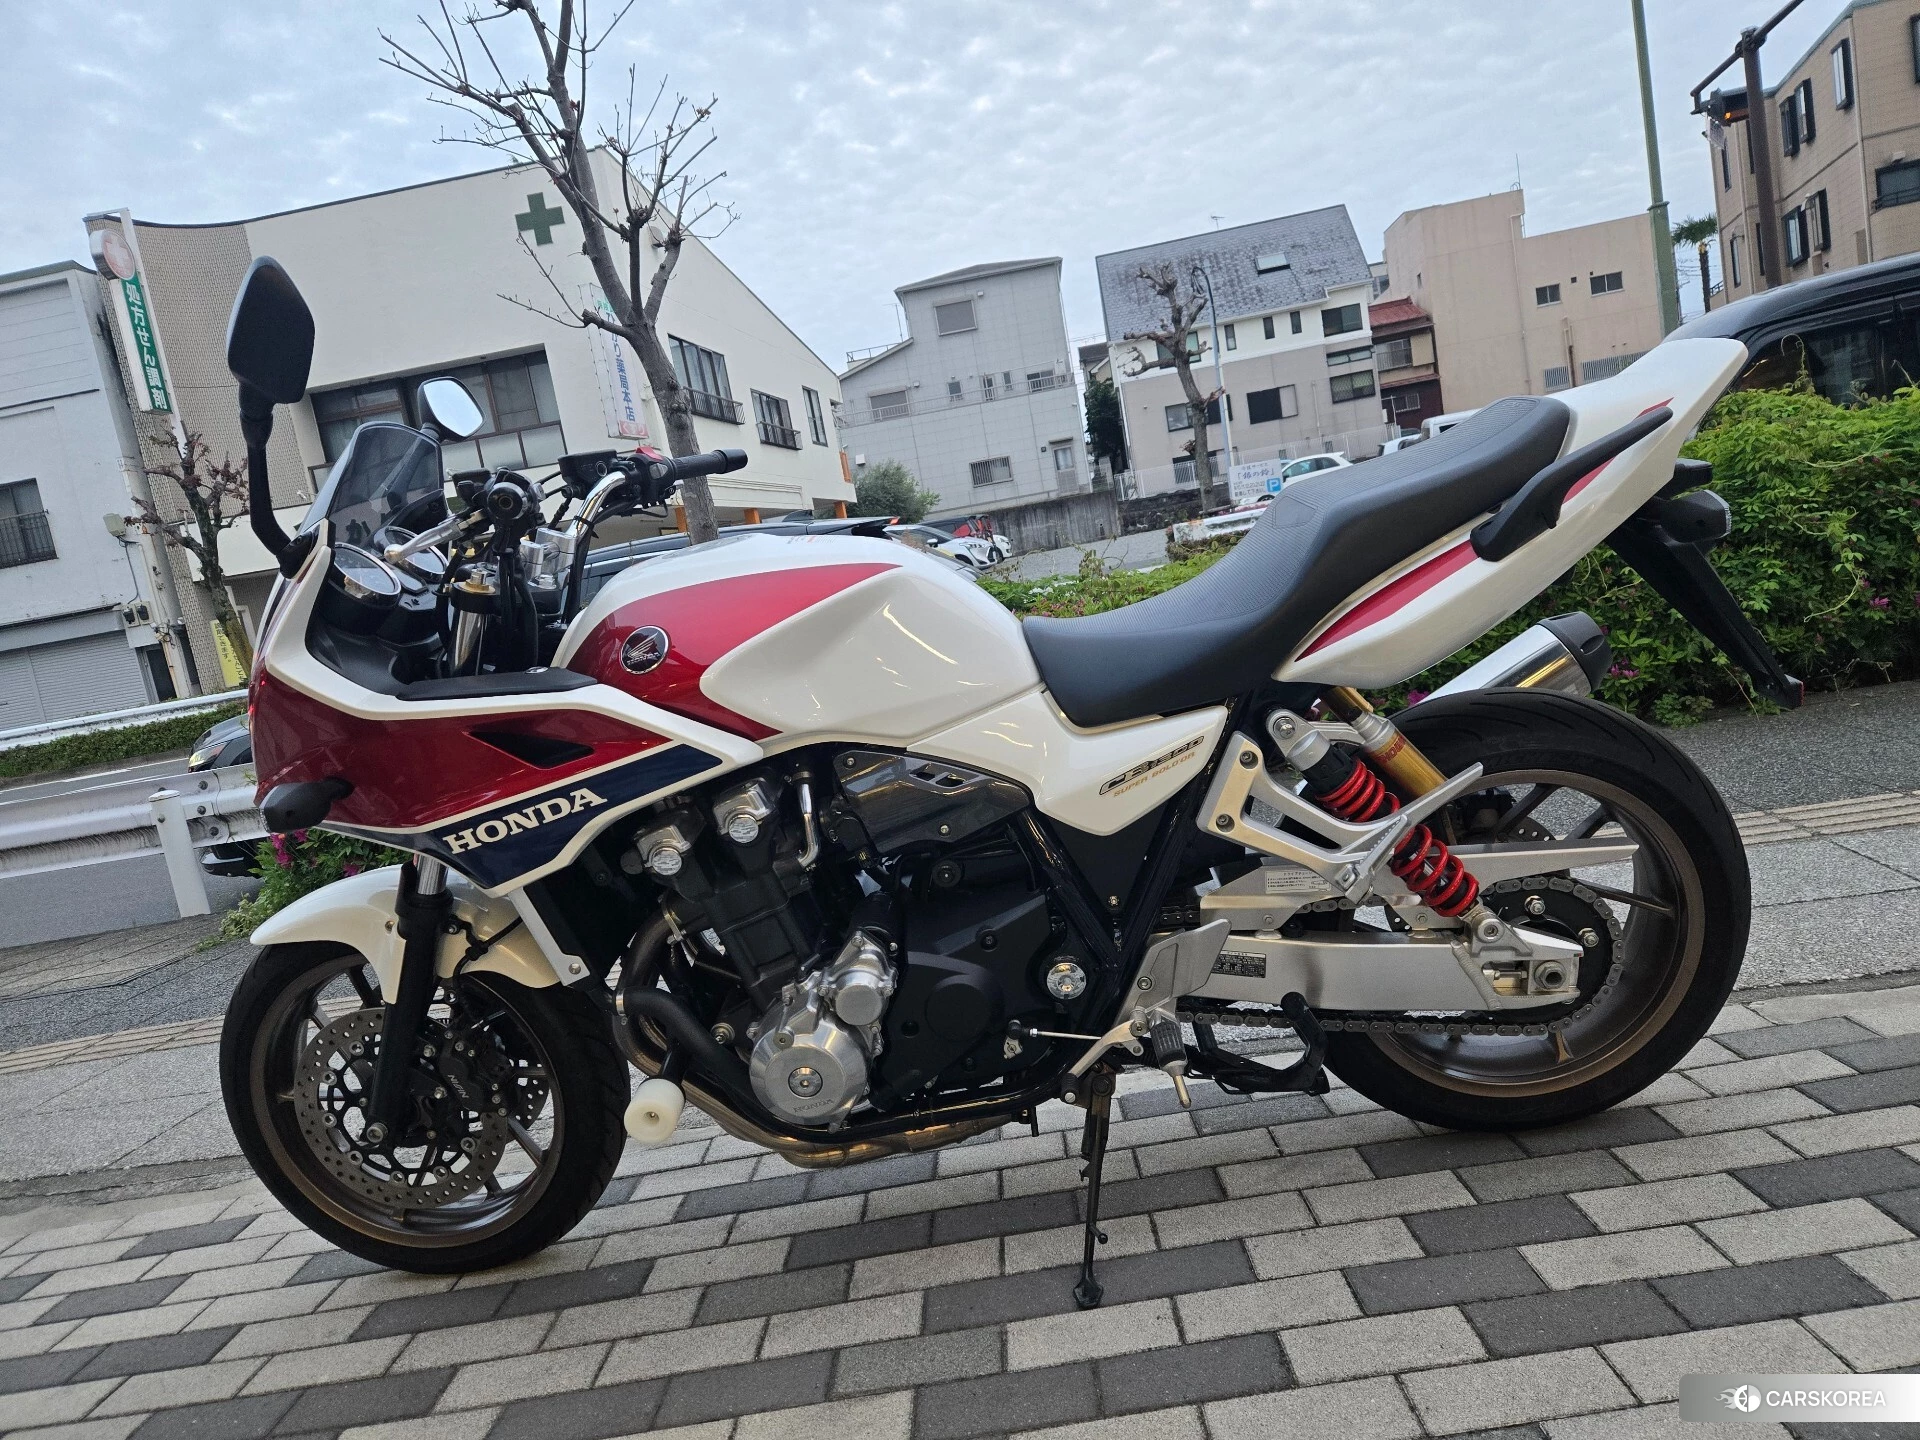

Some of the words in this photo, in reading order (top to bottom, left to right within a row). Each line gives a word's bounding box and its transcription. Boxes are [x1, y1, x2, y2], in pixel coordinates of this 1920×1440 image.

[125, 281, 168, 410] 処方せん調剤
[1113, 776, 1149, 797] SUPER
[442, 787, 608, 855] HONDA
[793, 1099, 834, 1112] HONDA
